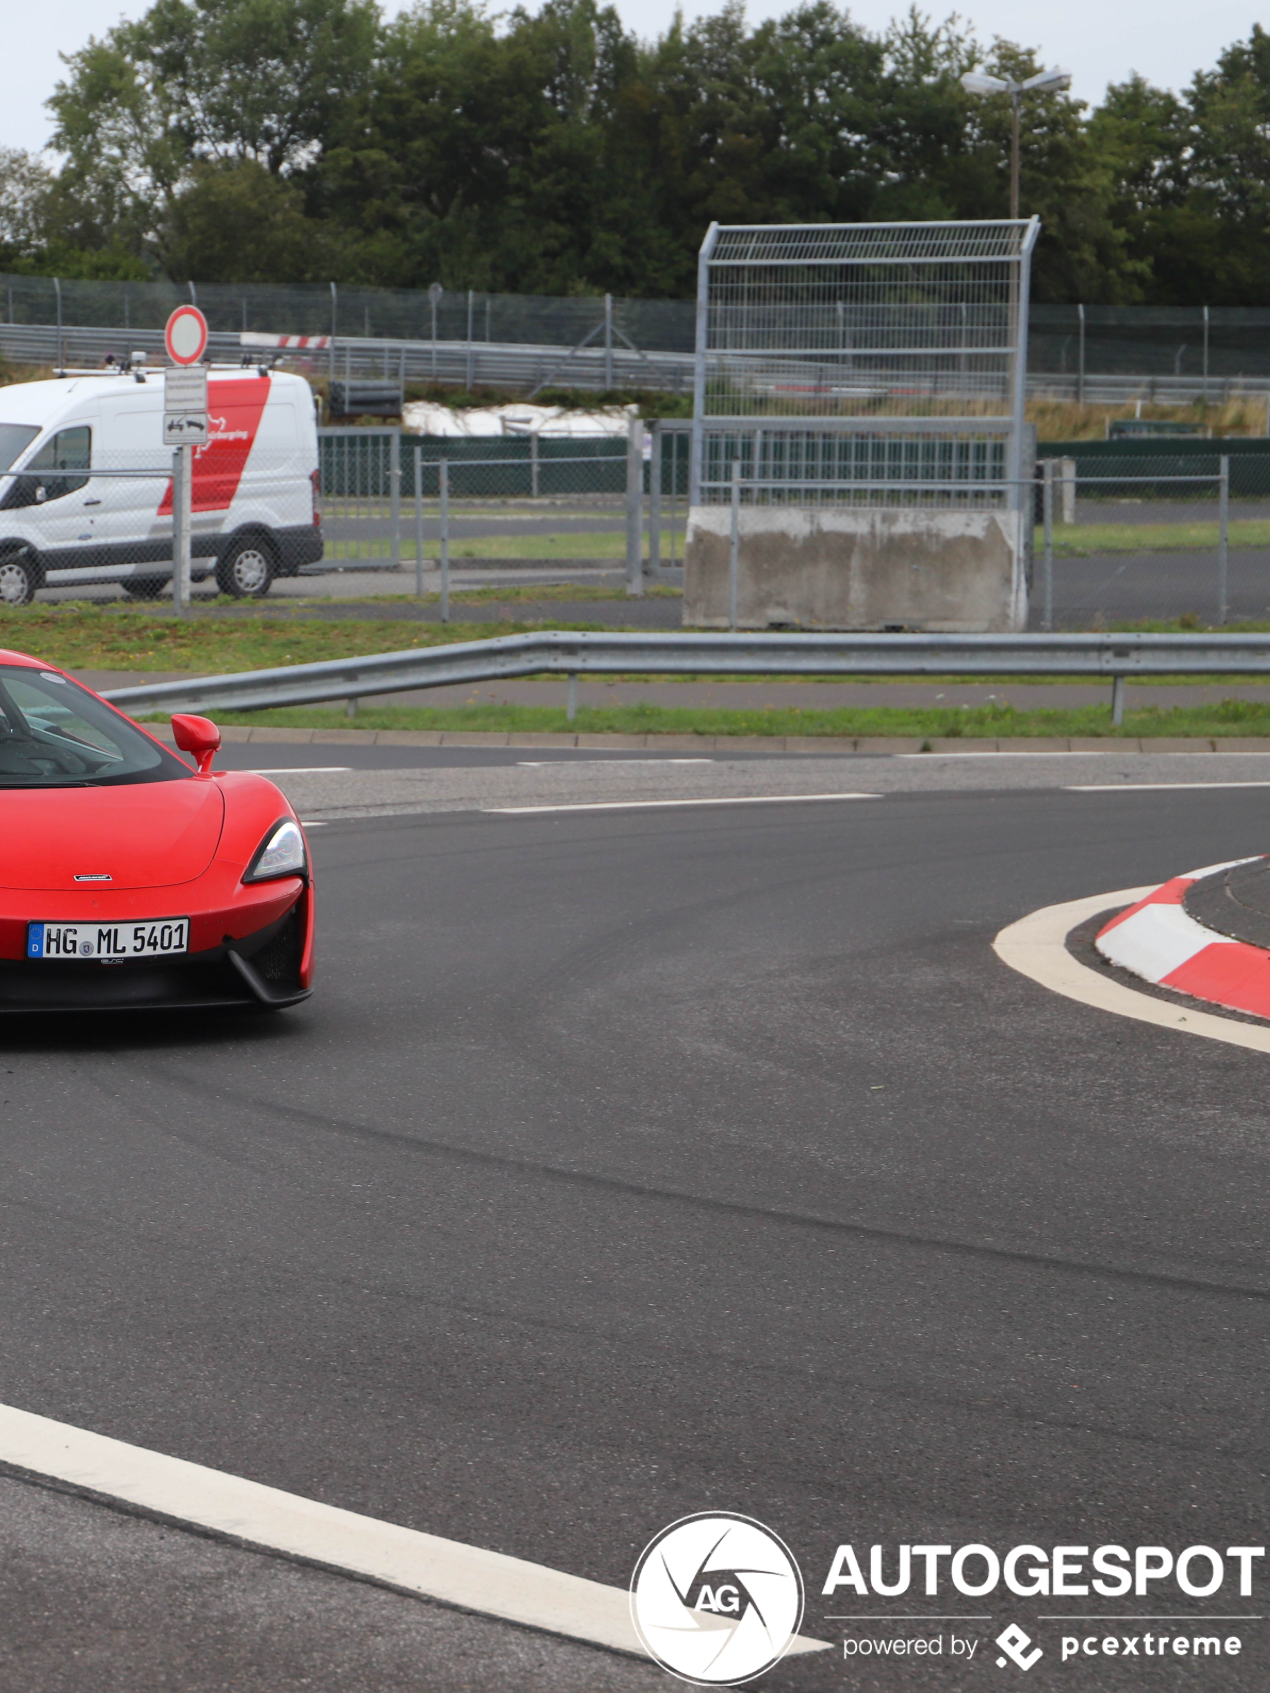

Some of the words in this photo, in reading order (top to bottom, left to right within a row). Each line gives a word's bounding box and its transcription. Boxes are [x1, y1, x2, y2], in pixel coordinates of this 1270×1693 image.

[31, 943, 39, 952] D
[45, 928, 78, 955] HG
[97, 928, 127, 954] ML
[133, 923, 185, 953] 5401
